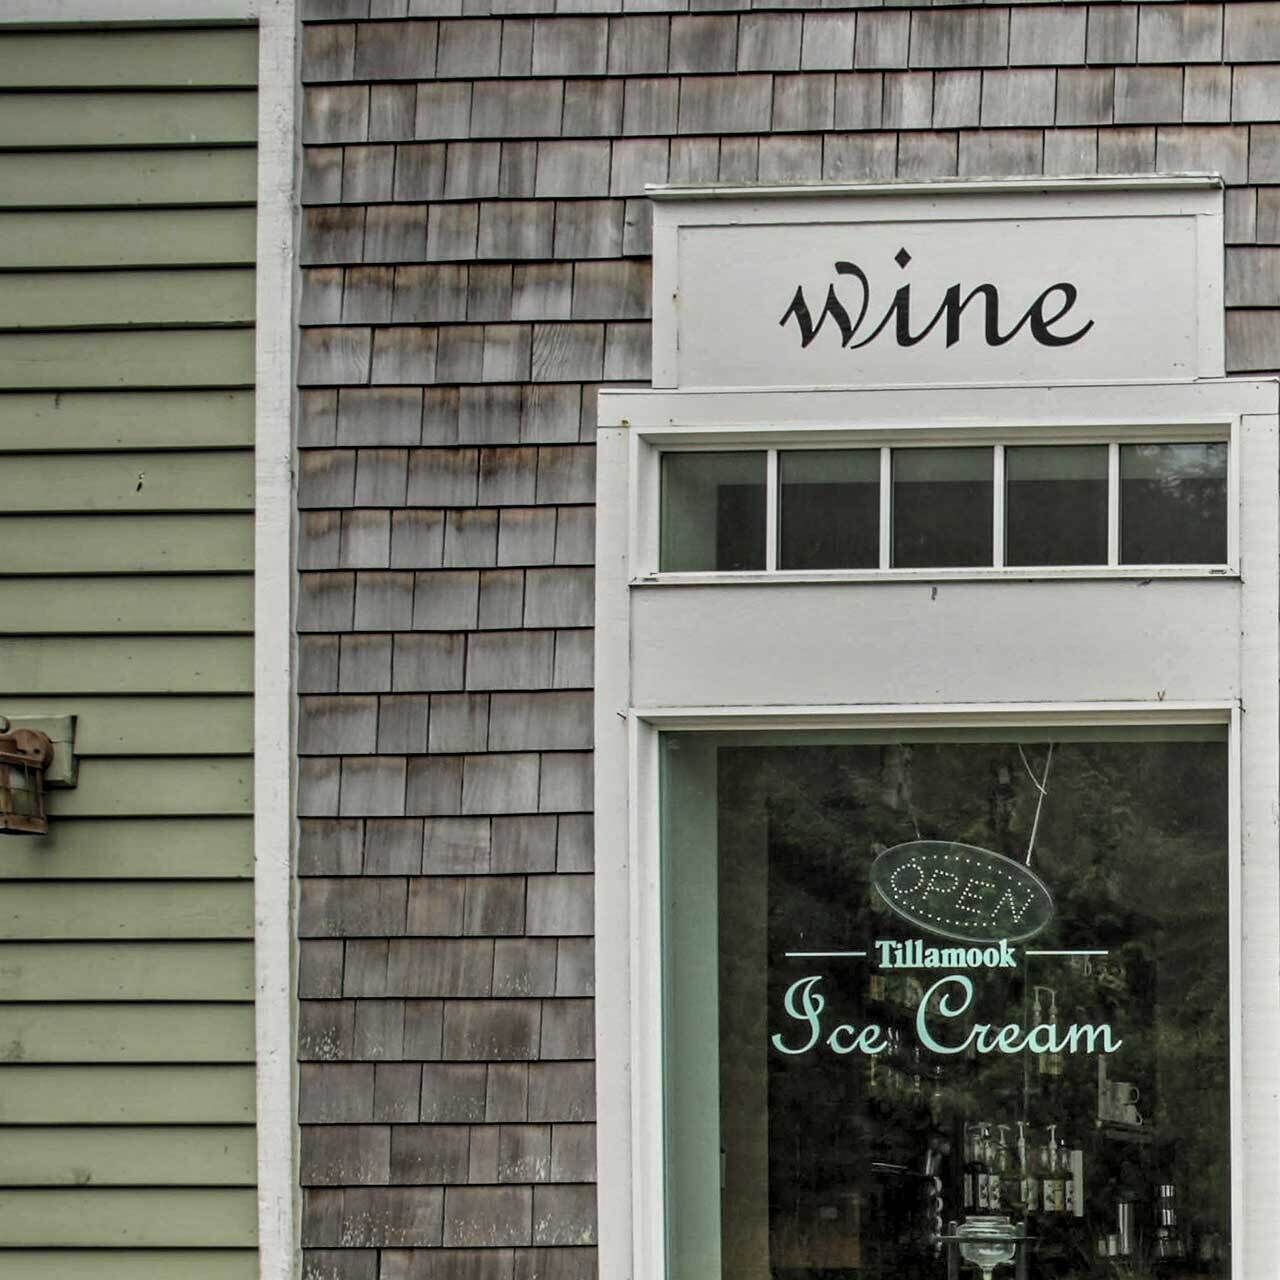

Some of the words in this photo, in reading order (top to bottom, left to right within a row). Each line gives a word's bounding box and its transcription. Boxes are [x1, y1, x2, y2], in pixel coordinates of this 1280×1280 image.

[891, 863, 1034, 923] OPEN
[874, 938, 1018, 969] Tillamook
[771, 974, 888, 1055] Ice
[915, 974, 1123, 1055] Cream
